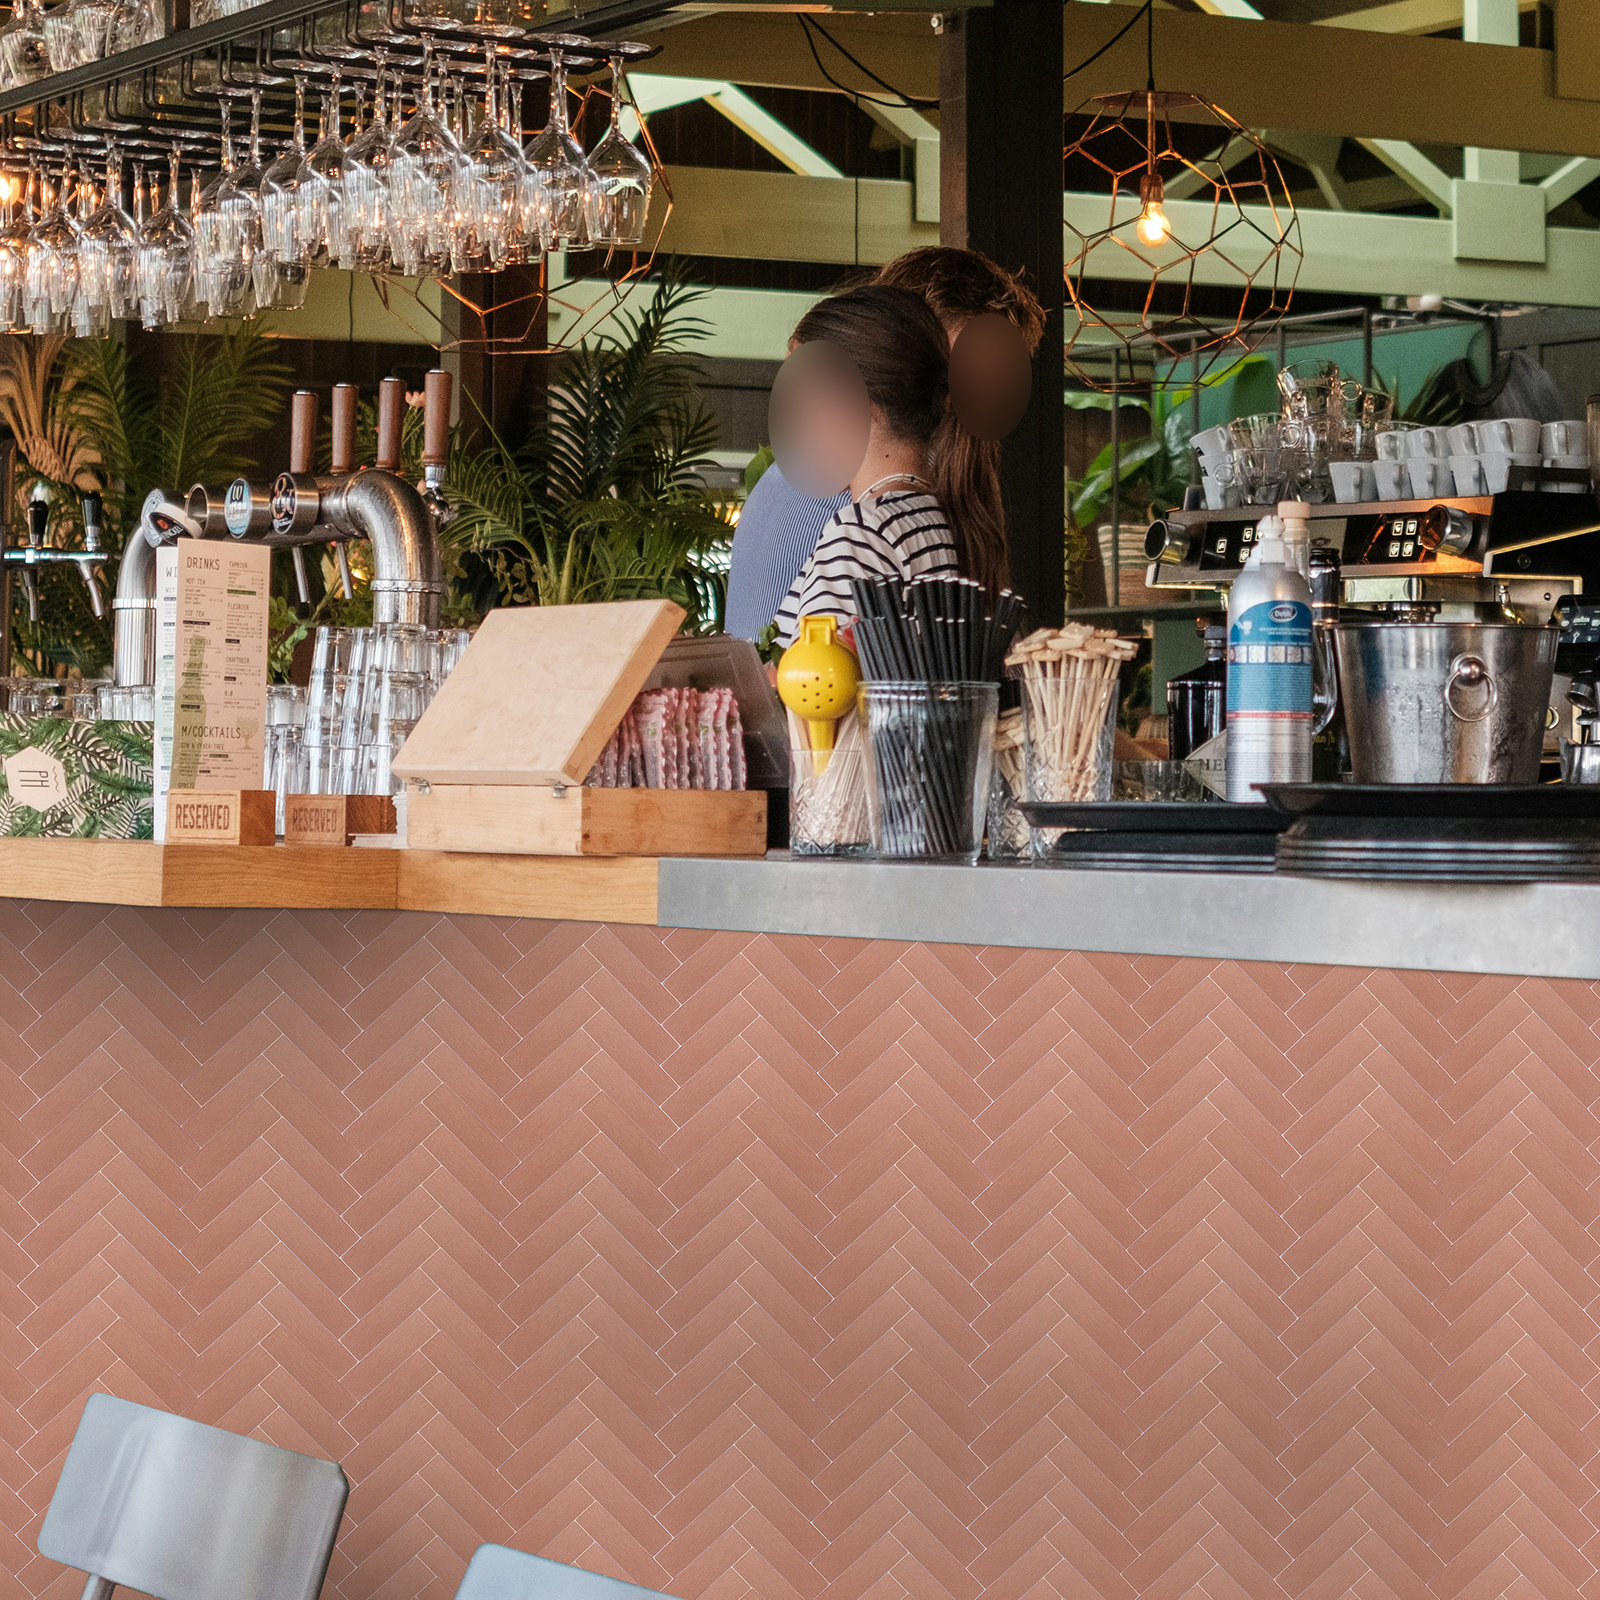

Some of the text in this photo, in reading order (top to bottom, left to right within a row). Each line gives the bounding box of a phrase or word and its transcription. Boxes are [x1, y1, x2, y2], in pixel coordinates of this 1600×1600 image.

[186, 556, 220, 571] DRINKS
[183, 637, 212, 646] ICE COFFEE
[225, 656, 250, 664] CRAFTBEER
[181, 725, 241, 739] M/COCKTAILS
[175, 803, 230, 830] RESERVED
[292, 807, 337, 833] RESERVED
